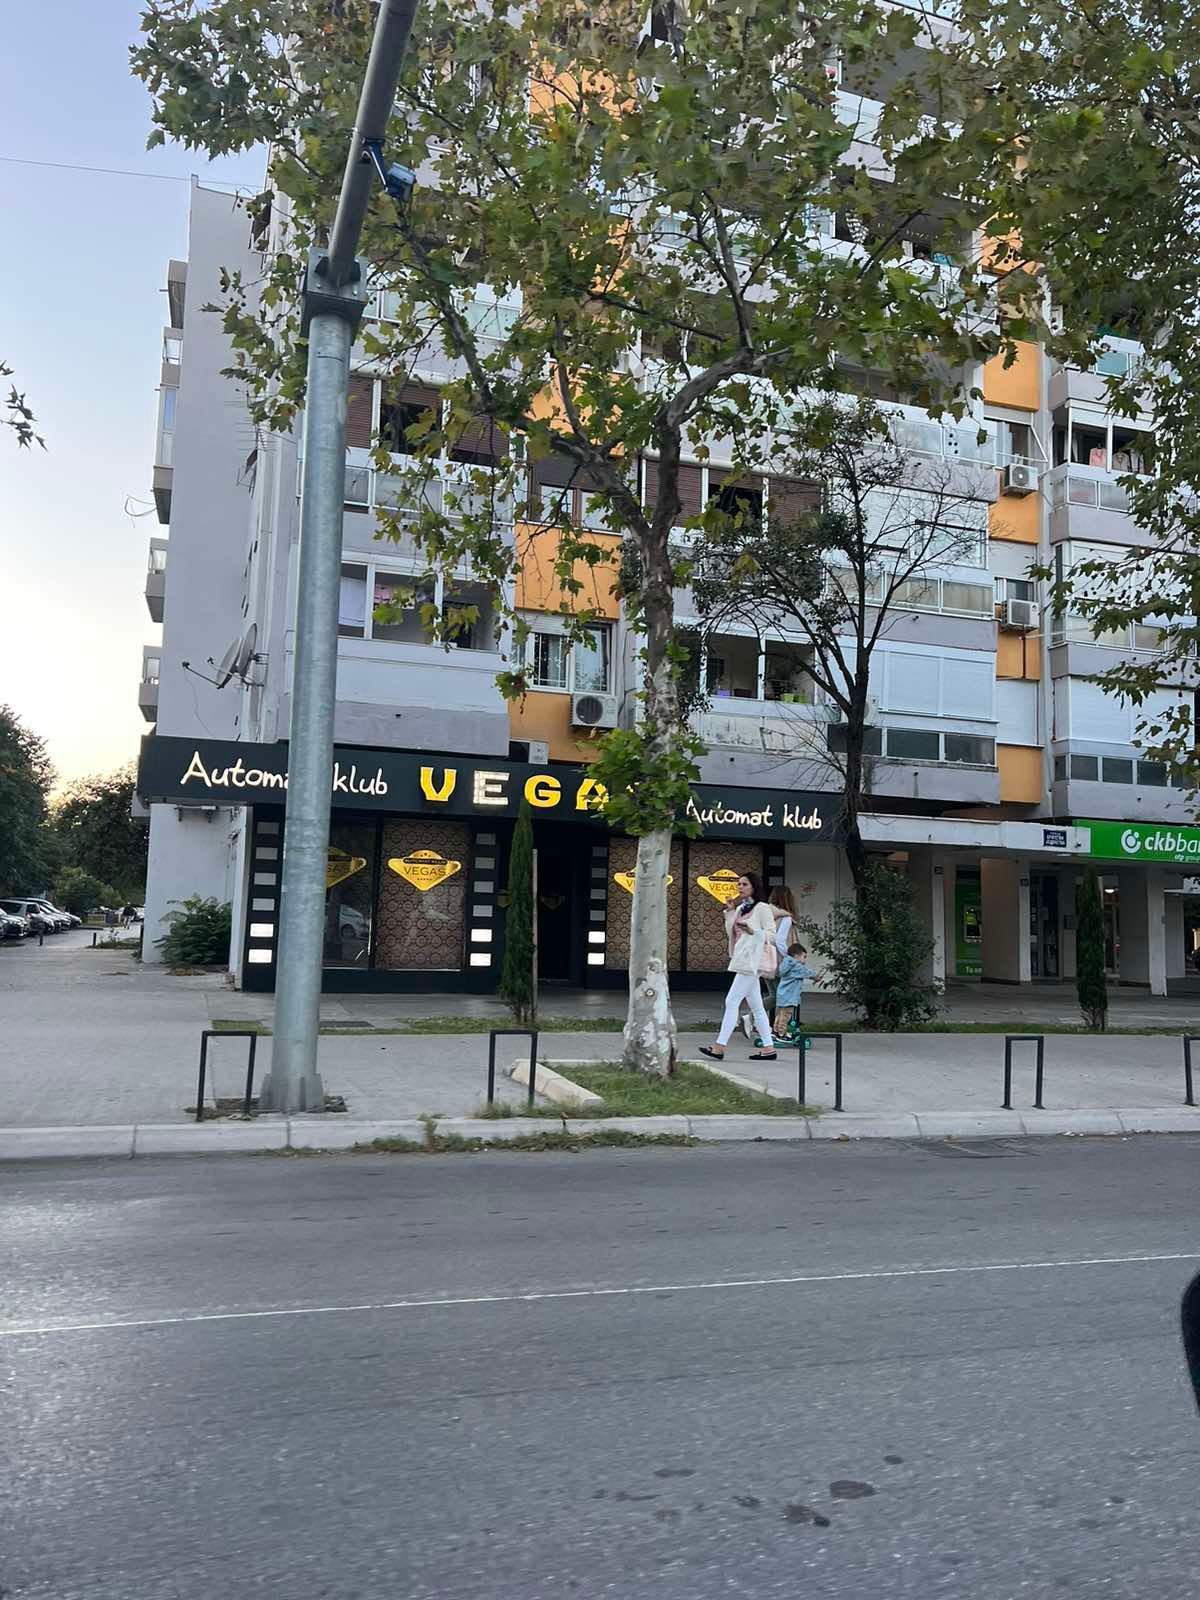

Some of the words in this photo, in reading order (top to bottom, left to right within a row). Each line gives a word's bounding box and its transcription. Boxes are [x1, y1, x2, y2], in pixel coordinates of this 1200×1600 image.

[180, 751, 289, 789] Autom
[333, 762, 388, 795] klub
[420, 766, 640, 811] VEGA
[686, 796, 773, 827] Automat
[783, 803, 822, 830] klub
[1144, 831, 1200, 854] ckbba
[403, 866, 446, 876] VEGAS
